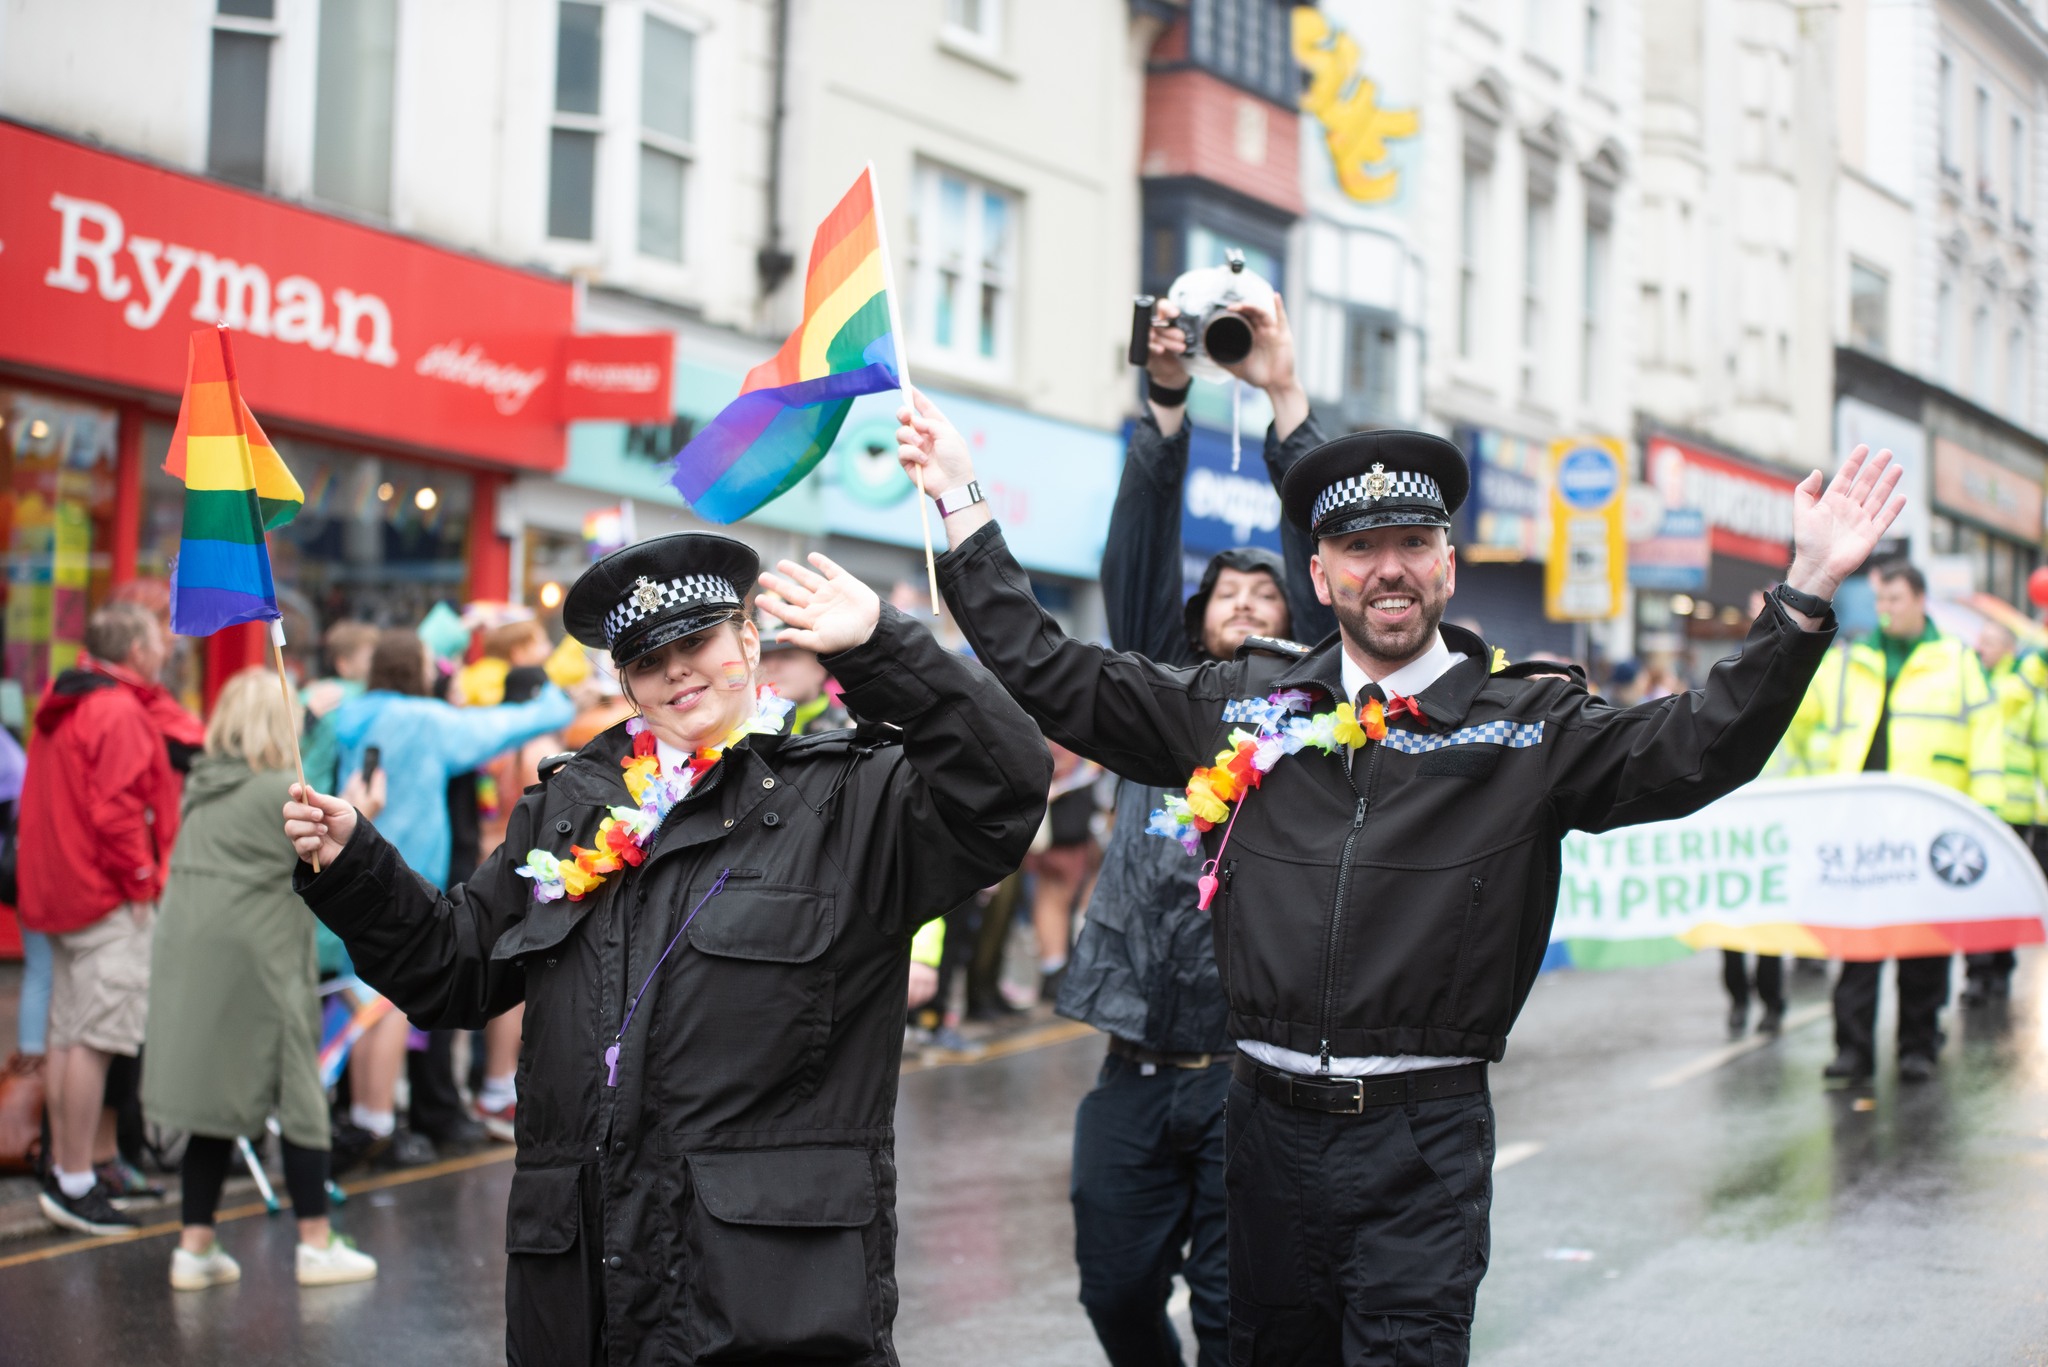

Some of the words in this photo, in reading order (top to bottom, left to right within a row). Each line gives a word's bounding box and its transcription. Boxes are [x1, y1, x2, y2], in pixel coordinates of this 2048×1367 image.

[45, 192, 398, 368] Ryman
[1854, 837, 1917, 872] John
[1617, 863, 1788, 919] PRIDE
